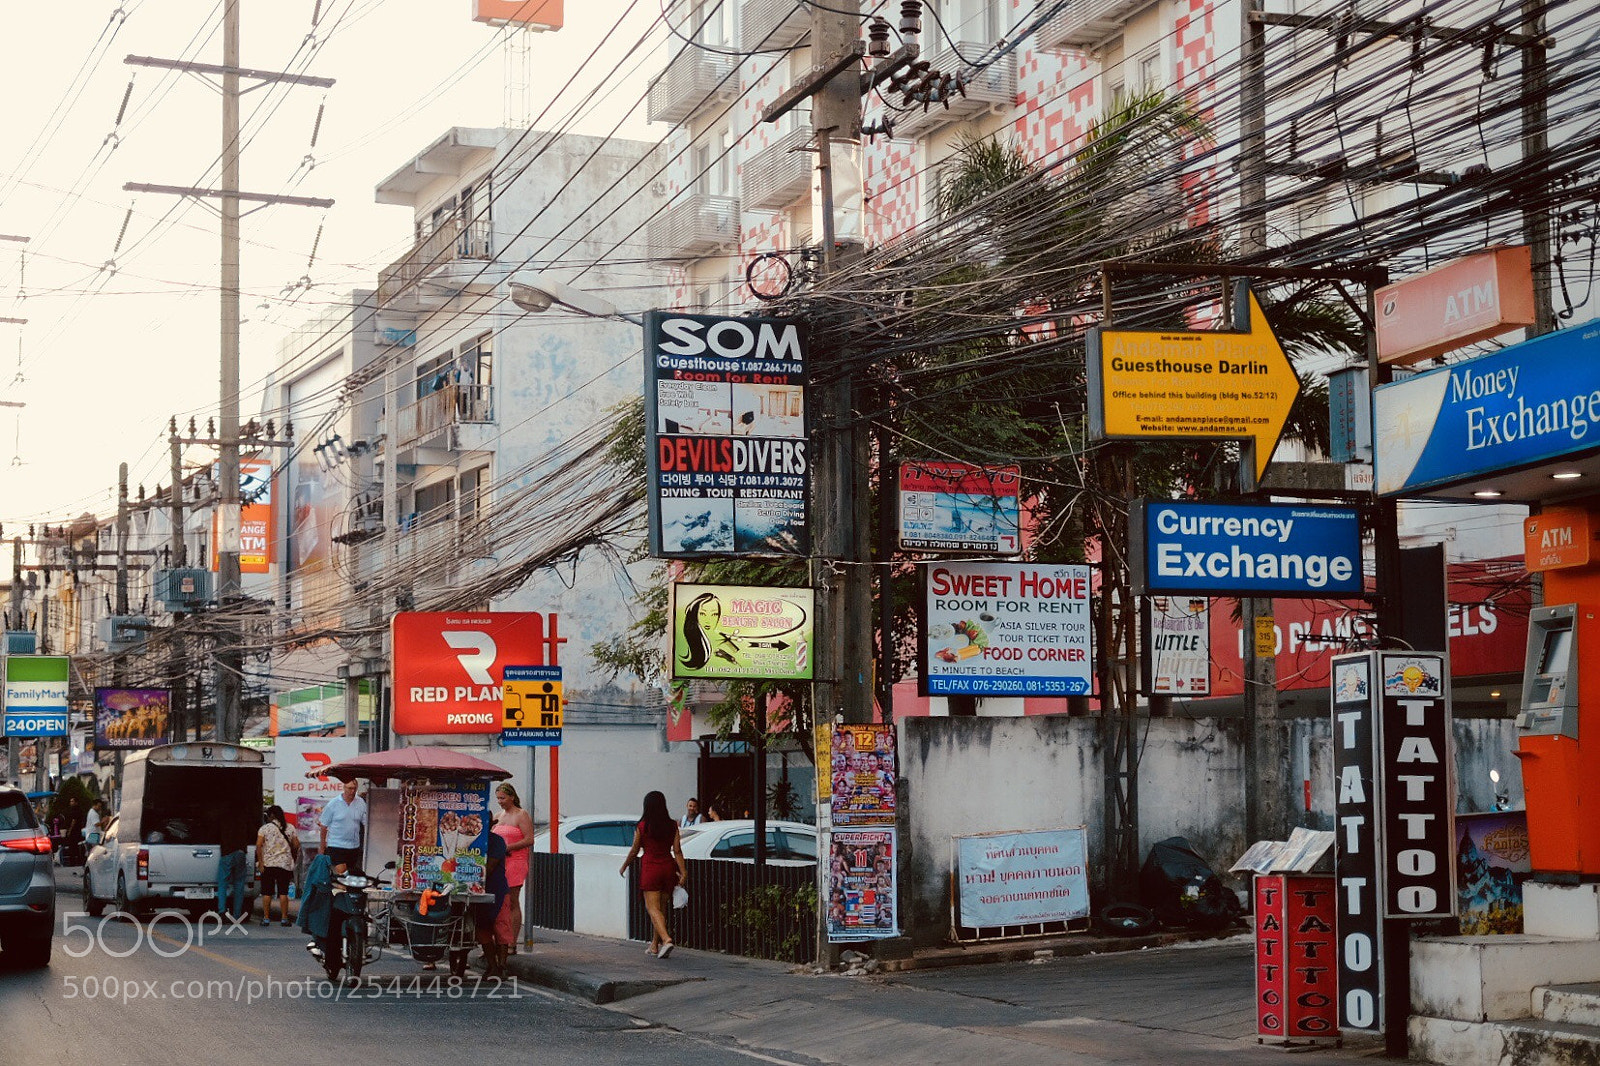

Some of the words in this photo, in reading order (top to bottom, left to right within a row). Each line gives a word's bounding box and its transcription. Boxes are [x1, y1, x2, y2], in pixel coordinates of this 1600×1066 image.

[1443, 280, 1494, 322] ATM
[658, 318, 803, 361] SOM
[658, 355, 739, 371] Guesthouse
[1112, 357, 1213, 374] Guesthouse
[1219, 360, 1268, 375] Darlin
[674, 370, 721, 382] Room
[725, 371, 748, 383] for
[753, 373, 788, 385] Rent
[1451, 366, 1520, 404] Money
[1112, 391, 1137, 399] Office
[1139, 391, 1166, 399] behind
[1186, 392, 1217, 401] building
[1466, 388, 1600, 451] Exchange
[662, 474, 691, 487] 다이빙
[694, 475, 714, 486] 투어
[718, 476, 738, 487] 식당
[661, 488, 700, 498] DIVING
[706, 488, 734, 498] TOUR
[740, 489, 804, 500] RESTAURANT
[782, 510, 805, 519] Diving
[241, 525, 266, 535] ANGE
[1157, 509, 1293, 542] Currency
[1541, 526, 1573, 549] ATM
[1157, 543, 1353, 588] Exchange
[932, 568, 1012, 597] SWEET
[1020, 571, 1086, 600] HOME
[731, 599, 783, 615] MAGIC
[935, 599, 988, 612] ROOM
[996, 601, 1030, 613] FOR
[1038, 602, 1085, 614] RENT
[1000, 621, 1022, 630] ASIA
[1025, 622, 1057, 631] SILVER
[1061, 622, 1086, 631] TOUR
[1448, 604, 1498, 638] ELS
[999, 634, 1024, 643] TOUR
[1028, 635, 1059, 643] TICKET
[1063, 635, 1085, 644] TAXI
[1155, 634, 1199, 651] LITTLE
[983, 646, 1023, 660] FOOD
[1027, 647, 1086, 662] CORNER
[942, 667, 977, 675] MINUTE
[980, 667, 993, 675] TO
[995, 667, 1026, 675] BEACH
[932, 679, 969, 691] TEL/FAX
[7, 689, 67, 702] FamilyMart
[410, 687, 448, 702] RED
[455, 686, 503, 701] PLAN
[447, 713, 494, 725] PATONG
[132, 738, 155, 746] Travel
[855, 733, 873, 746] 12
[283, 783, 304, 791] RED
[308, 783, 343, 792] PLANE
[1396, 699, 1439, 913] TATTOO
[418, 846, 443, 854] SAUCE
[455, 847, 481, 855] SALAD
[854, 849, 867, 868] 11
[1338, 711, 1374, 1028] TATTOO
[1260, 888, 1280, 1030] TATTOO
[1294, 890, 1333, 1032] TATTOO
